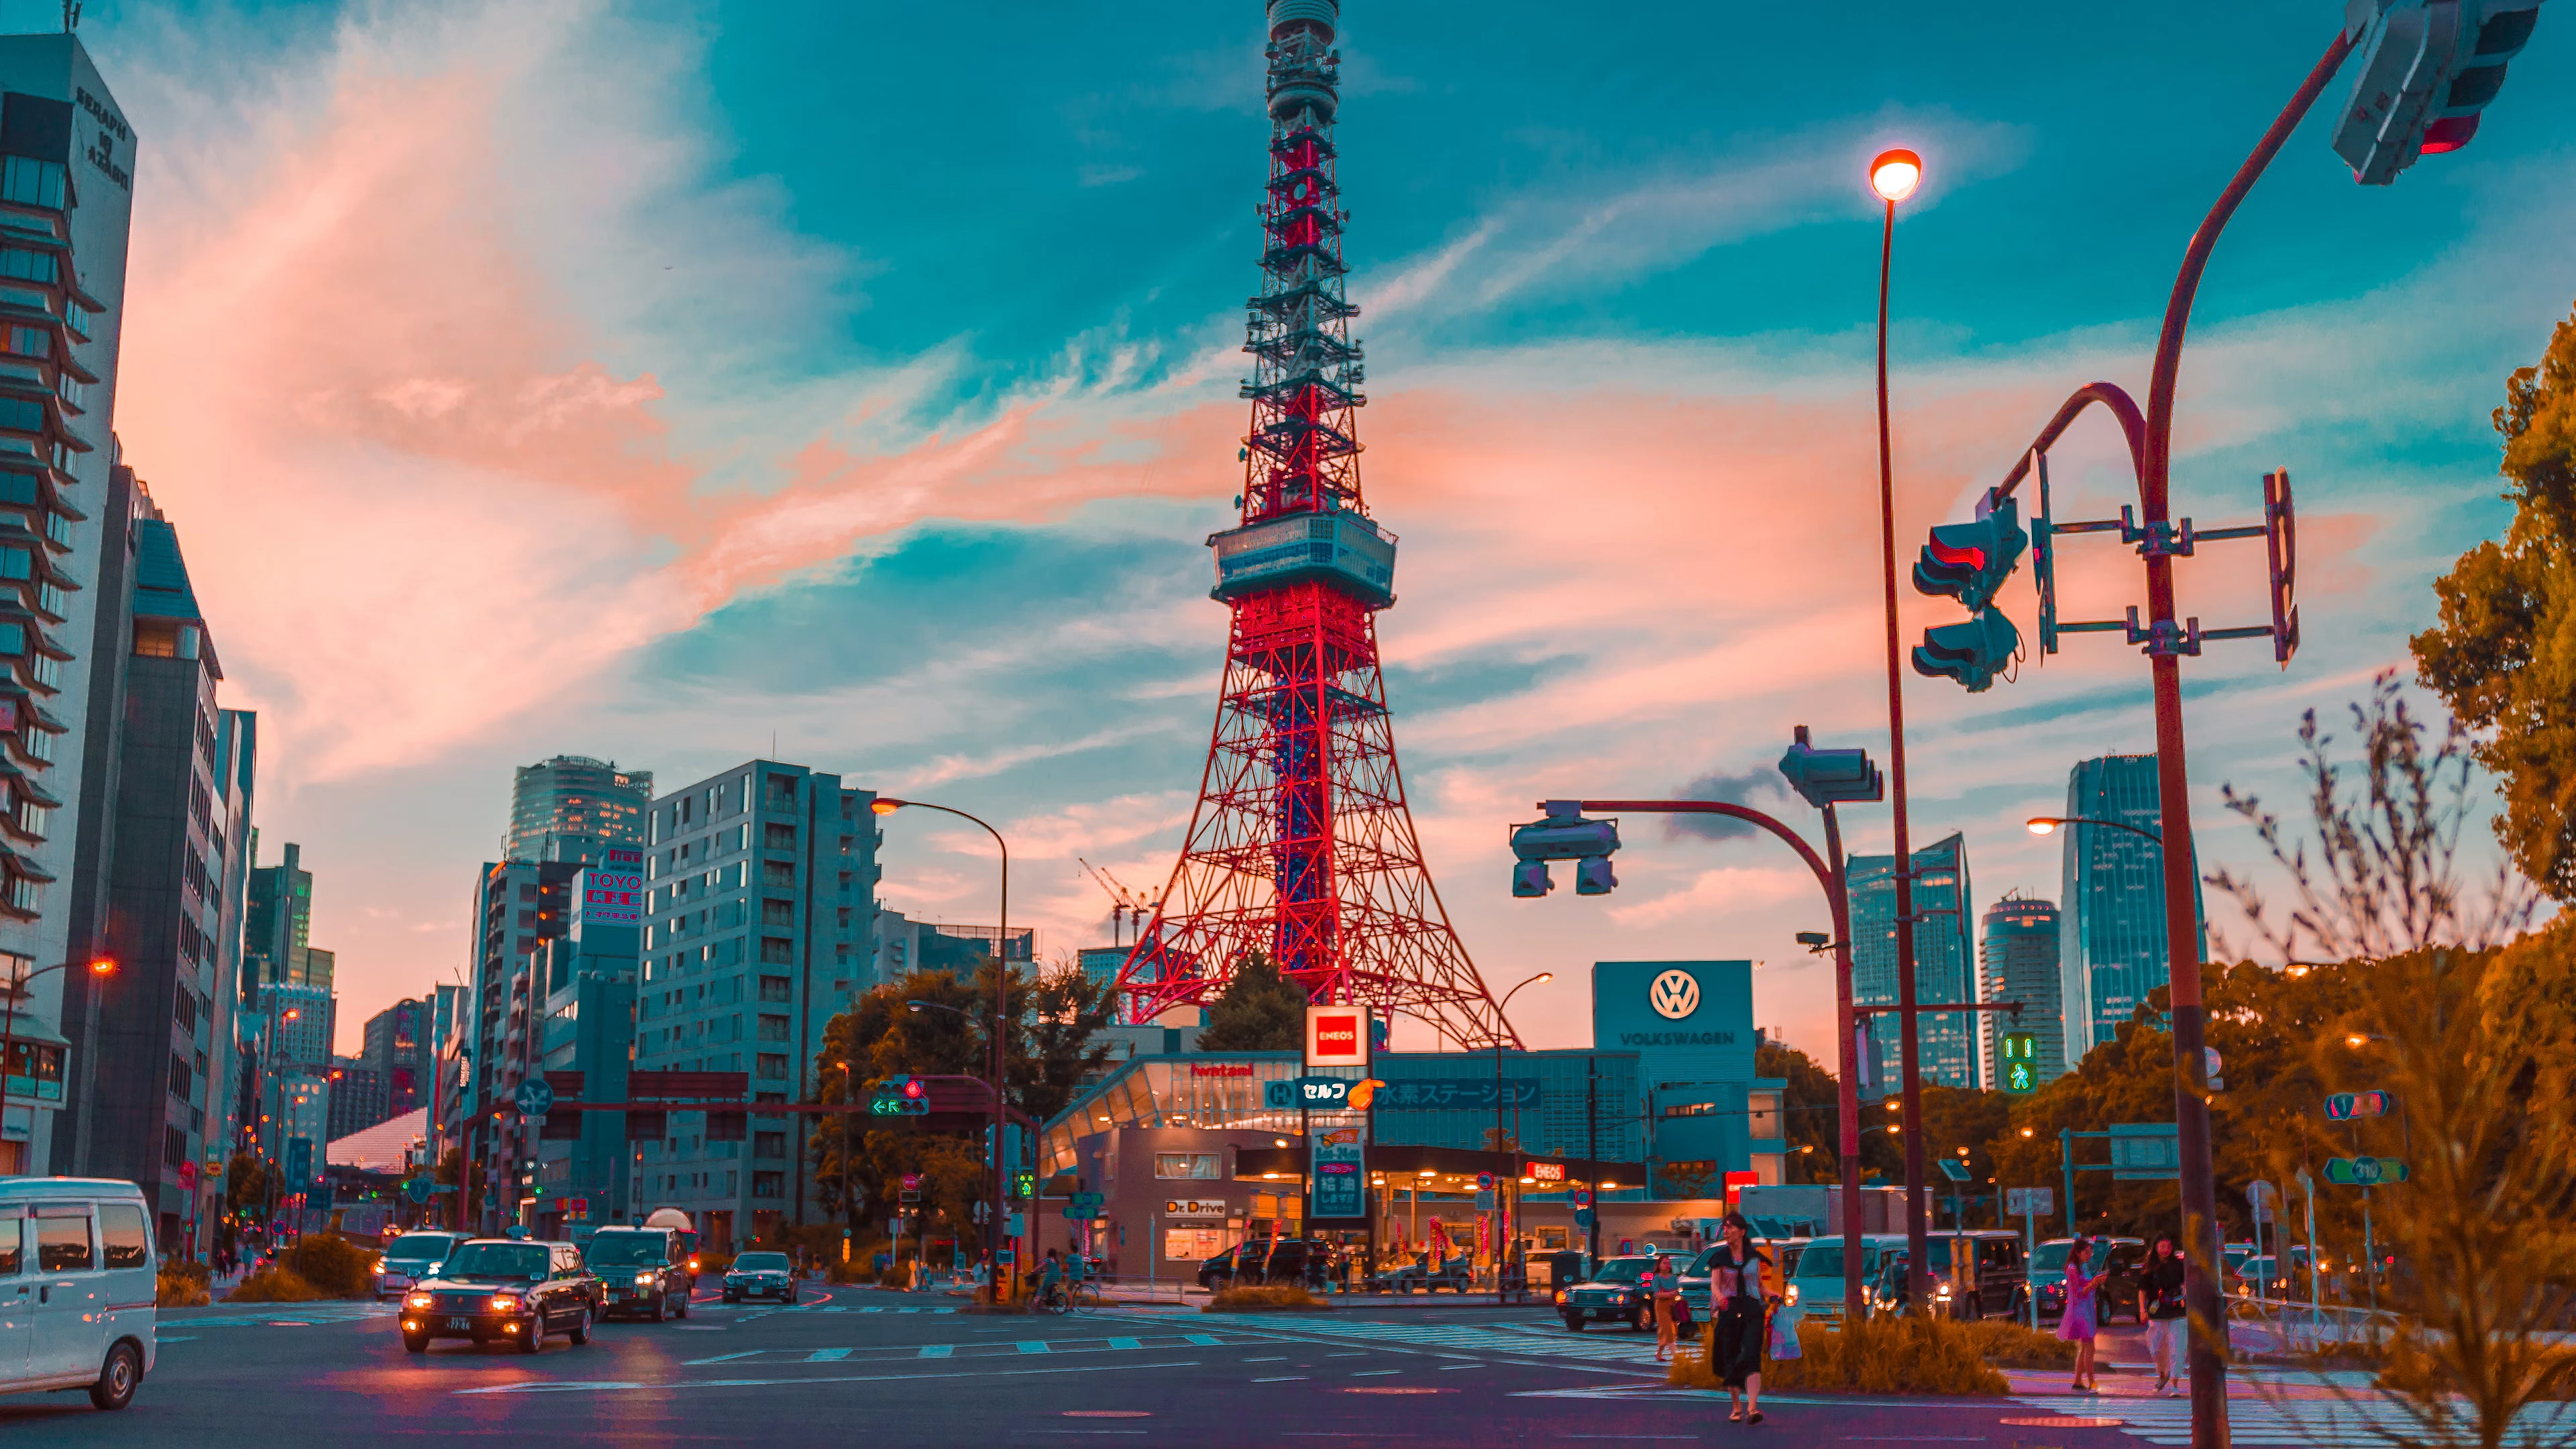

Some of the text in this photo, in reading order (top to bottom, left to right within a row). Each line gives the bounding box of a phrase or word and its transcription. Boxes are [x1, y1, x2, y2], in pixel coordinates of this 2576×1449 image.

[1319, 1032, 1354, 1040] ENEOS
[1620, 1032, 1734, 1045] VOLKSWAGEN
[1303, 1083, 1346, 1099] セルフ
[1377, 1084, 1536, 1106] 水素ステーション
[1535, 1165, 1562, 1180] ENEOS
[1167, 1201, 1224, 1213] Dr. Drive
